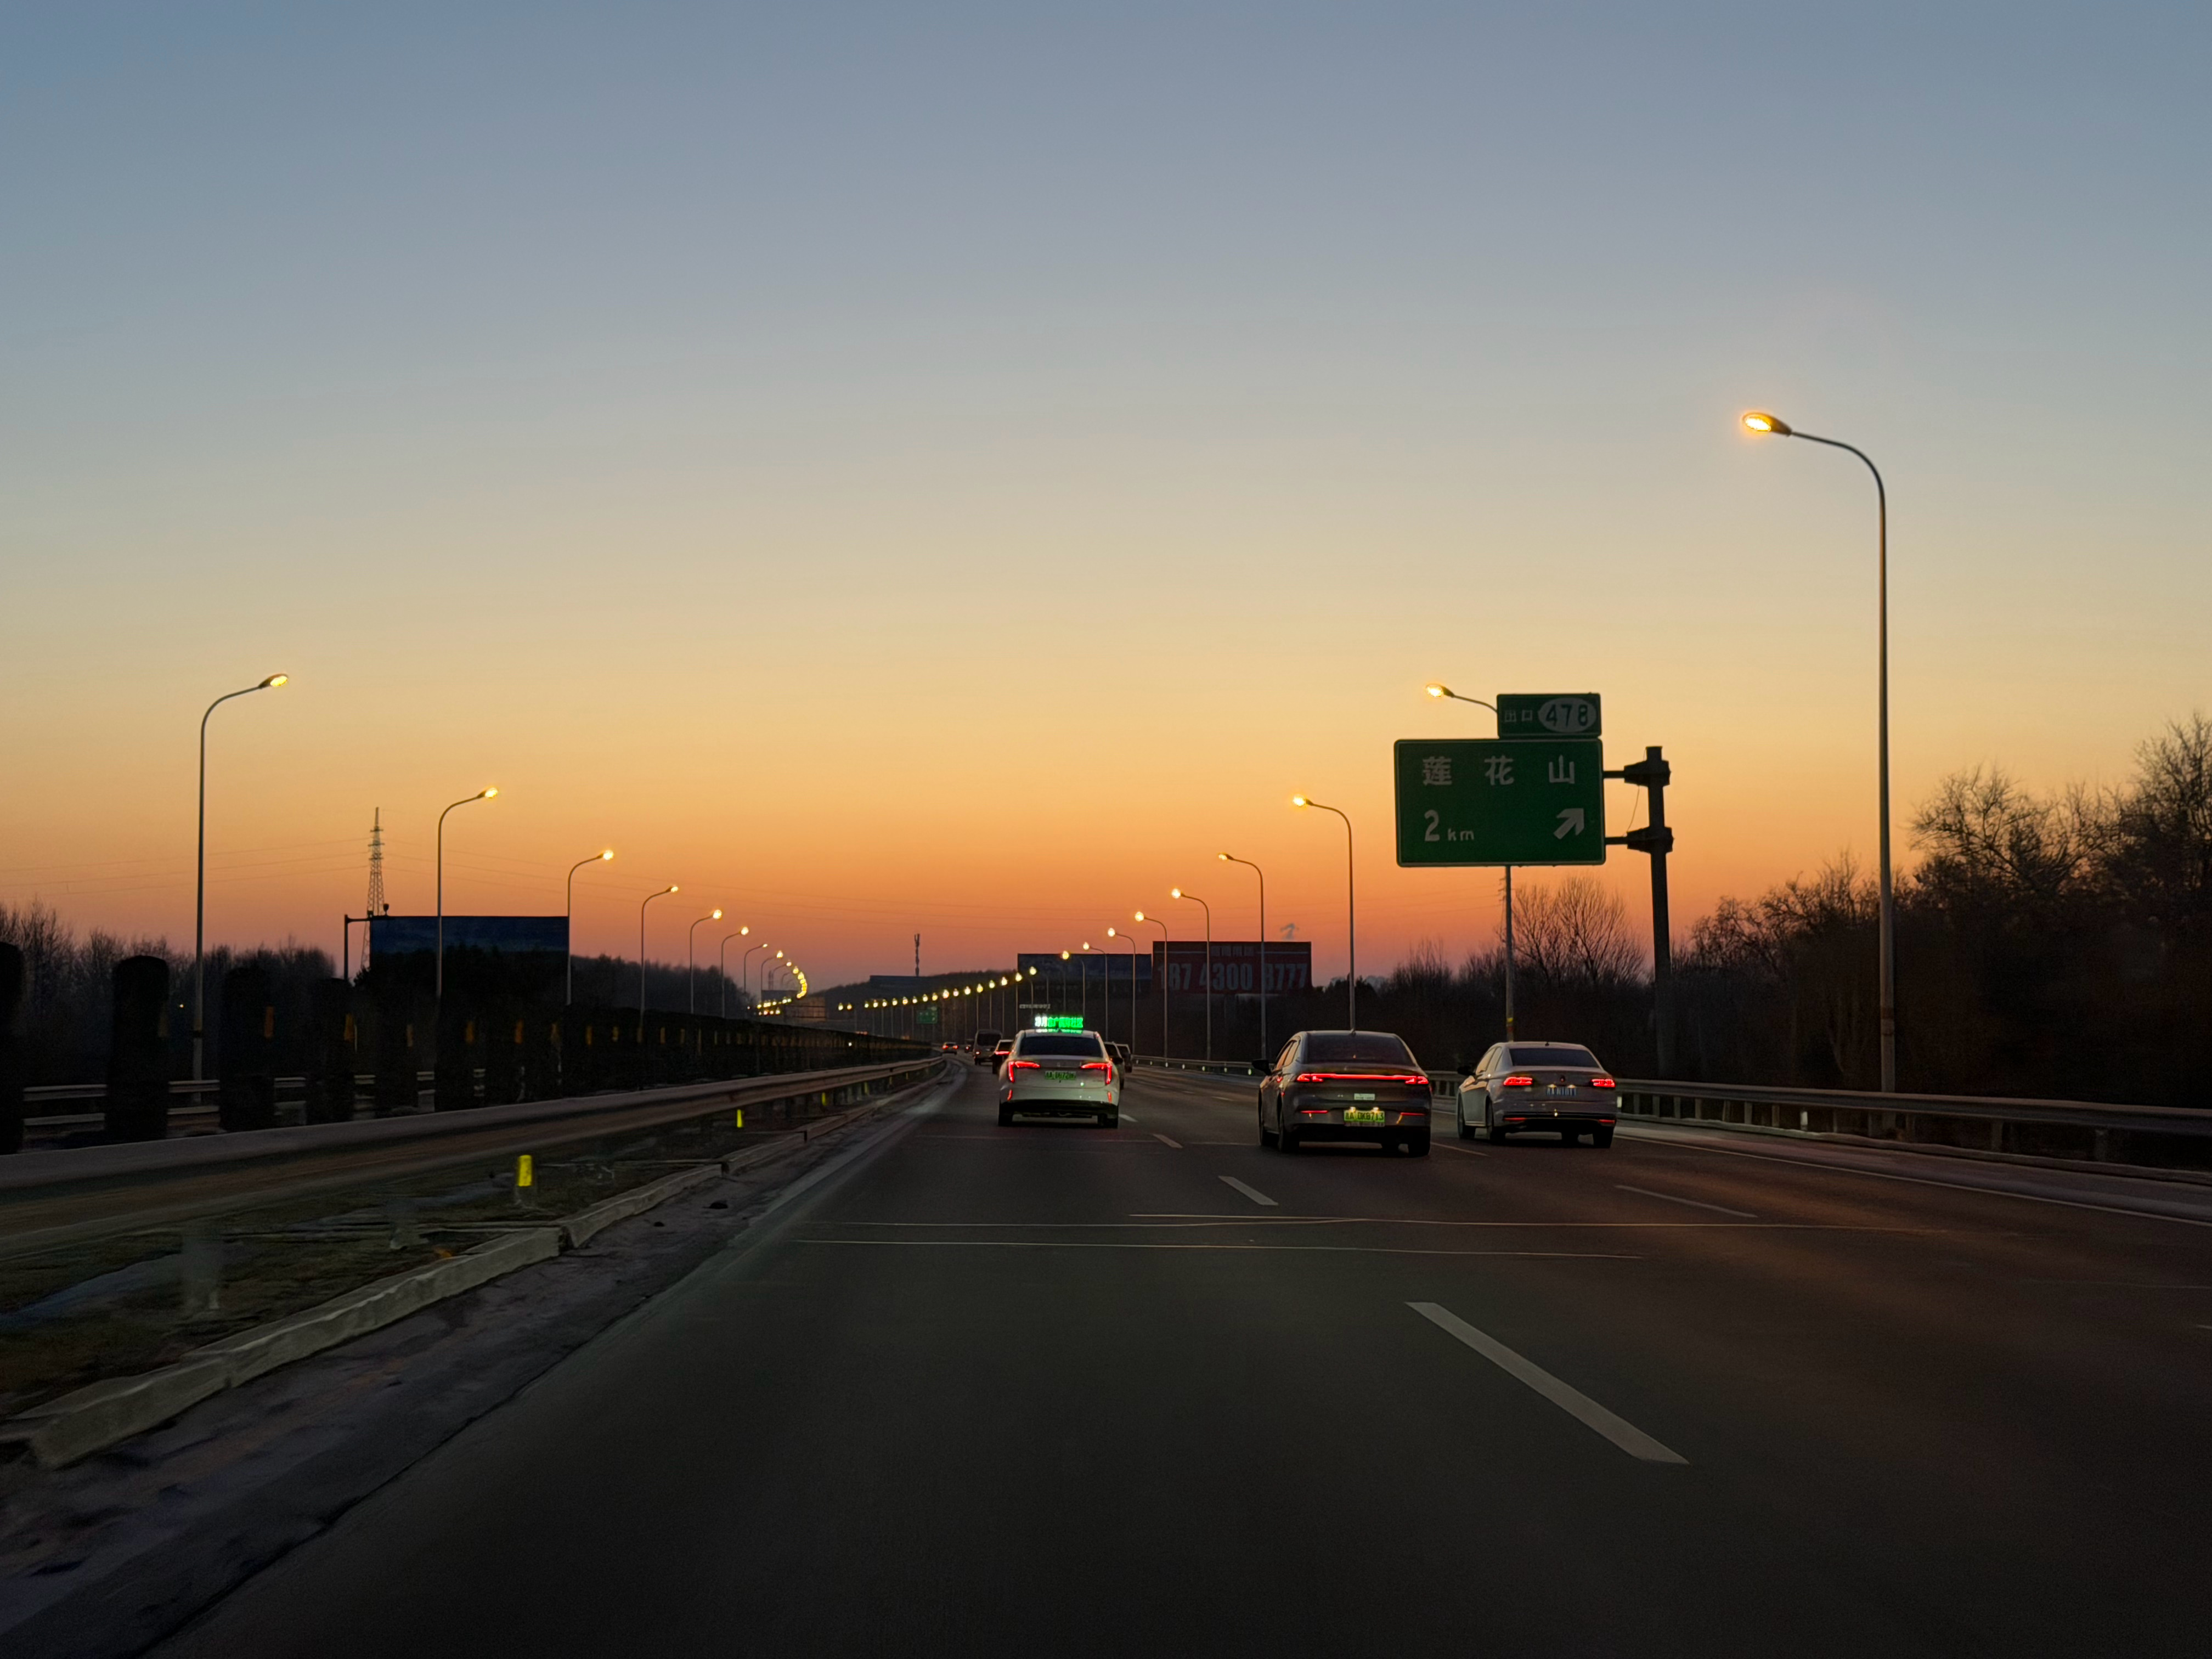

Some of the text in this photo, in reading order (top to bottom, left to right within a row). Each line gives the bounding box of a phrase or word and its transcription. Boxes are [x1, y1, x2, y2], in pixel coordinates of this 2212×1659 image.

[1504, 709, 1533, 723] 出口
[1545, 704, 1588, 727] 478
[1425, 809, 1474, 841] 2 km
[1199, 963, 1252, 990] 4300
